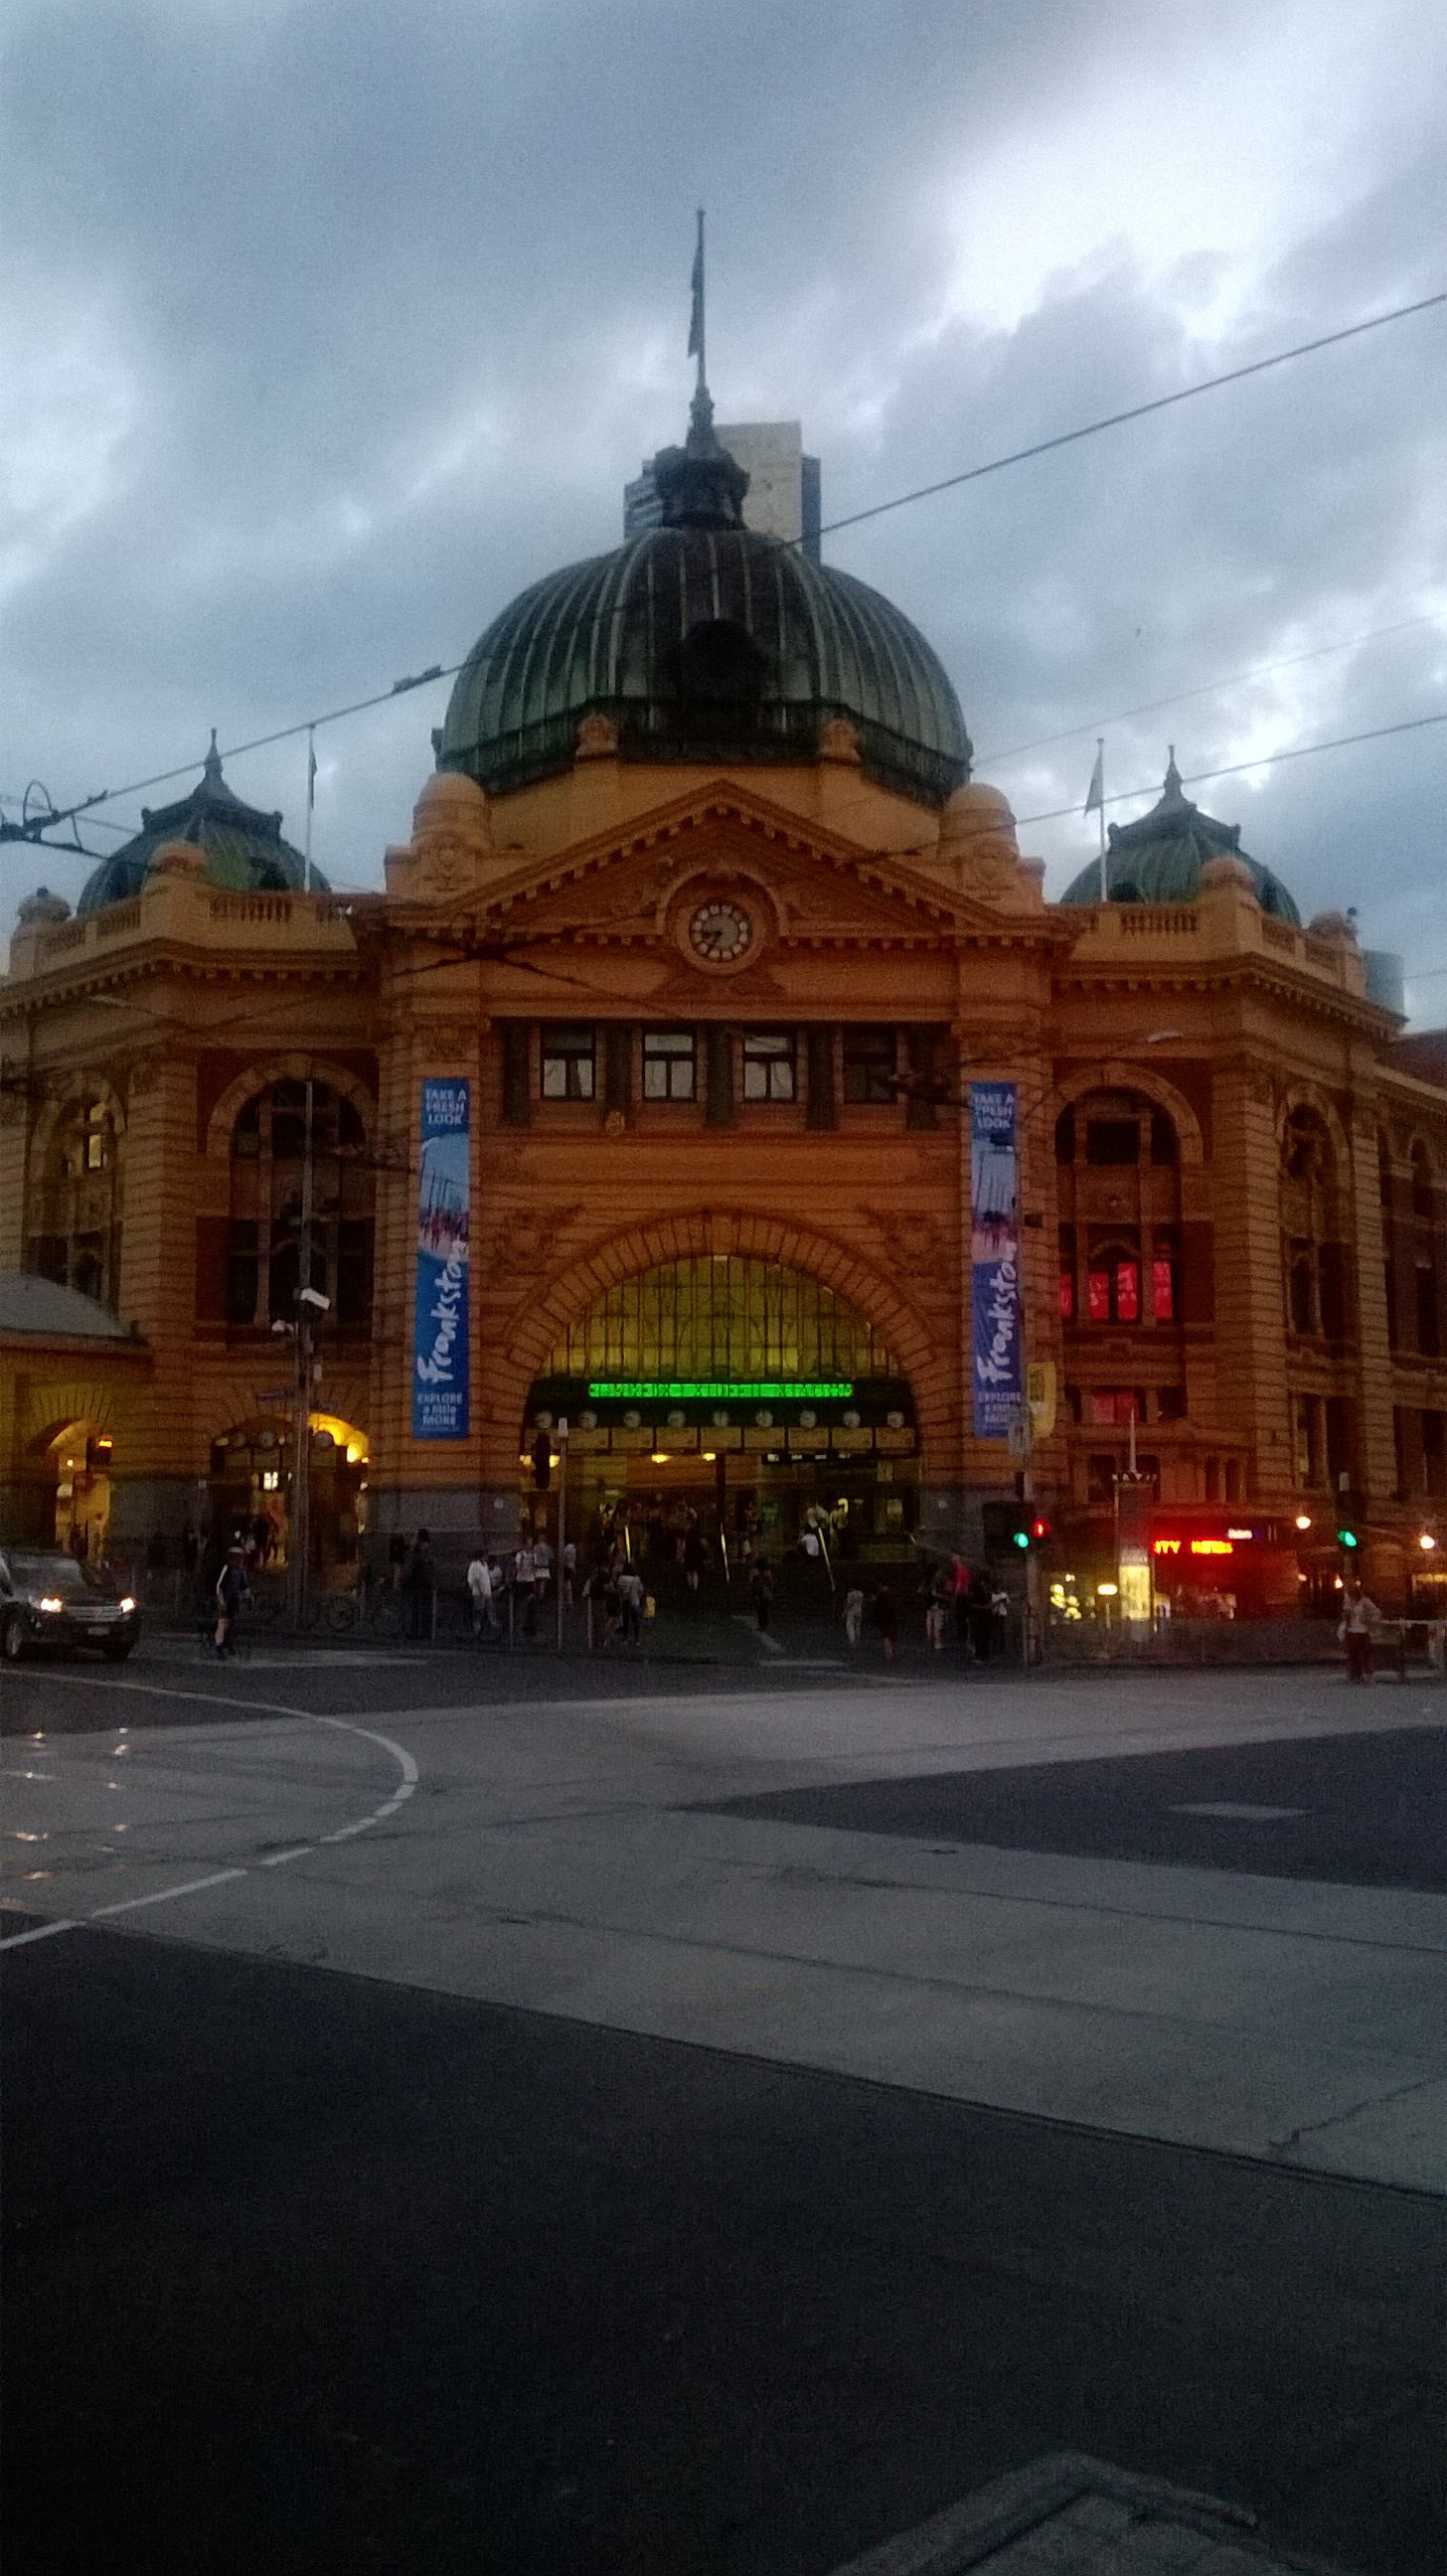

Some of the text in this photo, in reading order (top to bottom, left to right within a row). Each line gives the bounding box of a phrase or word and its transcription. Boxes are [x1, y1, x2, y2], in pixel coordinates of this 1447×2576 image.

[425, 1088, 467, 1100] TAKE A
[1005, 1093, 1015, 1104] A
[425, 1100, 465, 1112] FRESH
[428, 1113, 462, 1125] LOOK
